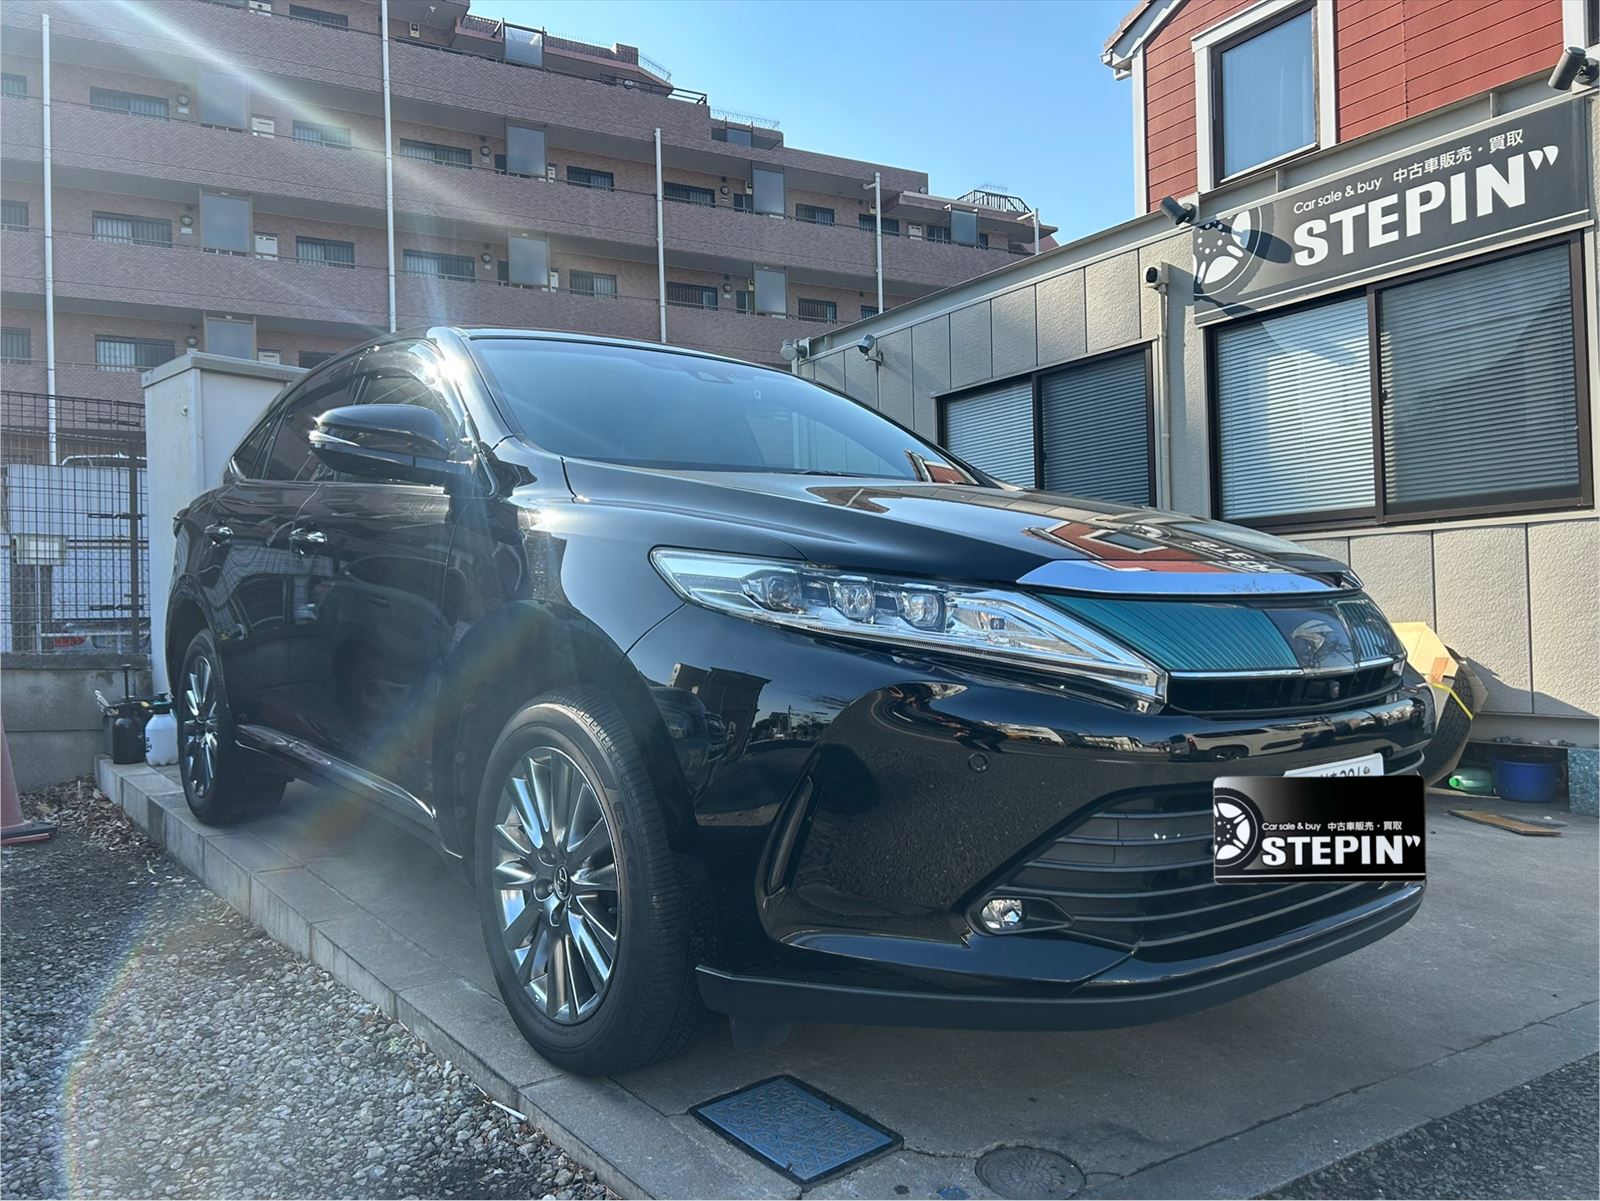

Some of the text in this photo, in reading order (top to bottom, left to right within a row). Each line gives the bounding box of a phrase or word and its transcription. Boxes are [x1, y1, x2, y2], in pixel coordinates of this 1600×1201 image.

[1293, 177, 1383, 214] Car sale & buy
